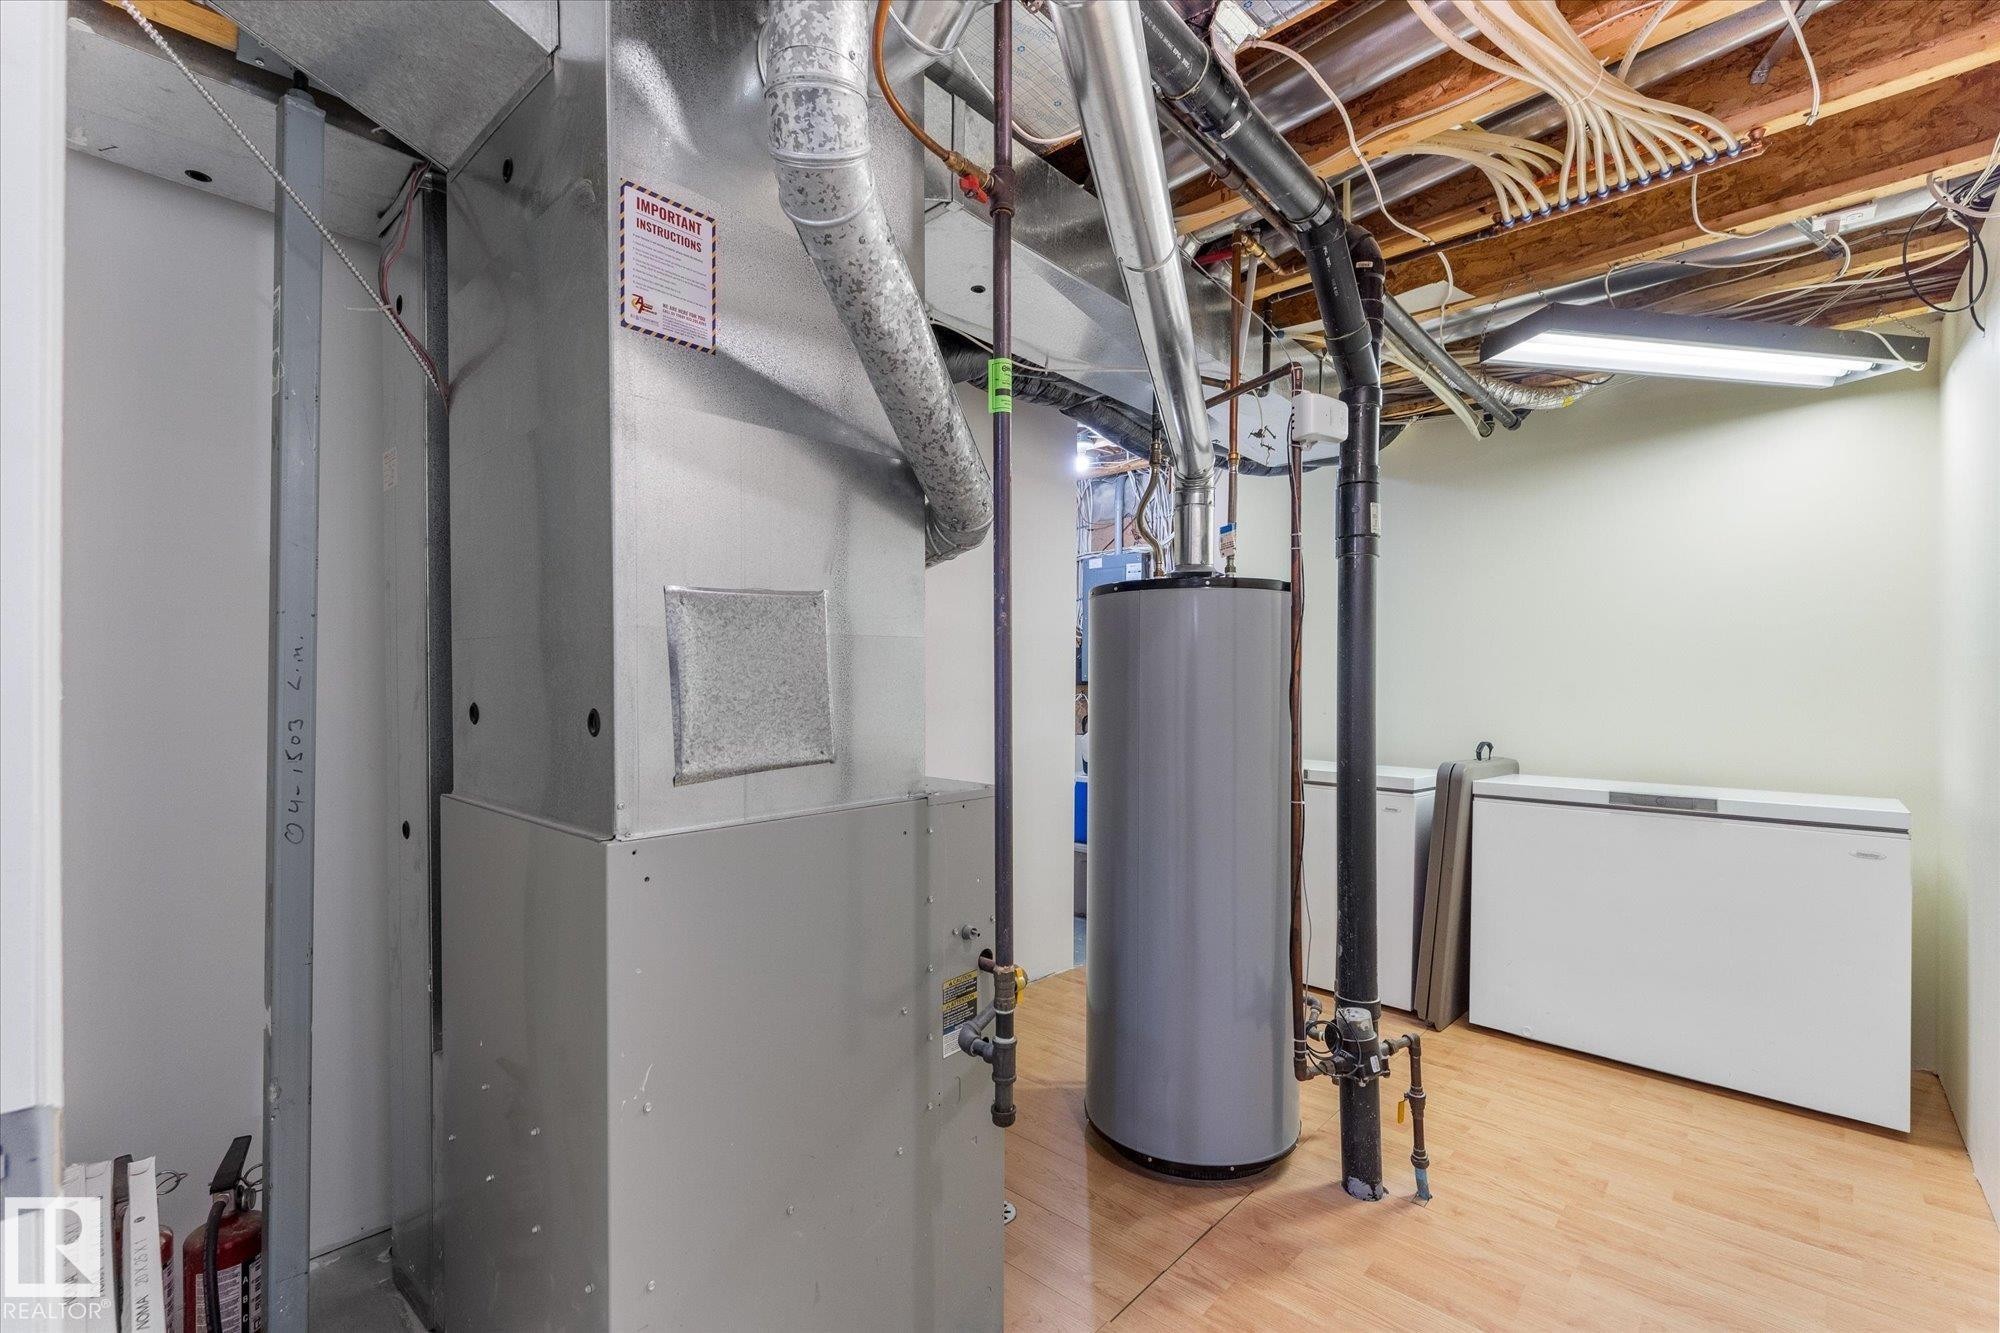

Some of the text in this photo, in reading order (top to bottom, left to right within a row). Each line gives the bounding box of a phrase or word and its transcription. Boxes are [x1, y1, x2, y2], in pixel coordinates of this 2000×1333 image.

[636, 197, 702, 235] IMPORTANT
[636, 218, 702, 252] INSTRUCTIONS
[242, 1276, 249, 1284] A
[135, 1294, 150, 1331] NOMA
[242, 1295, 249, 1304] B
